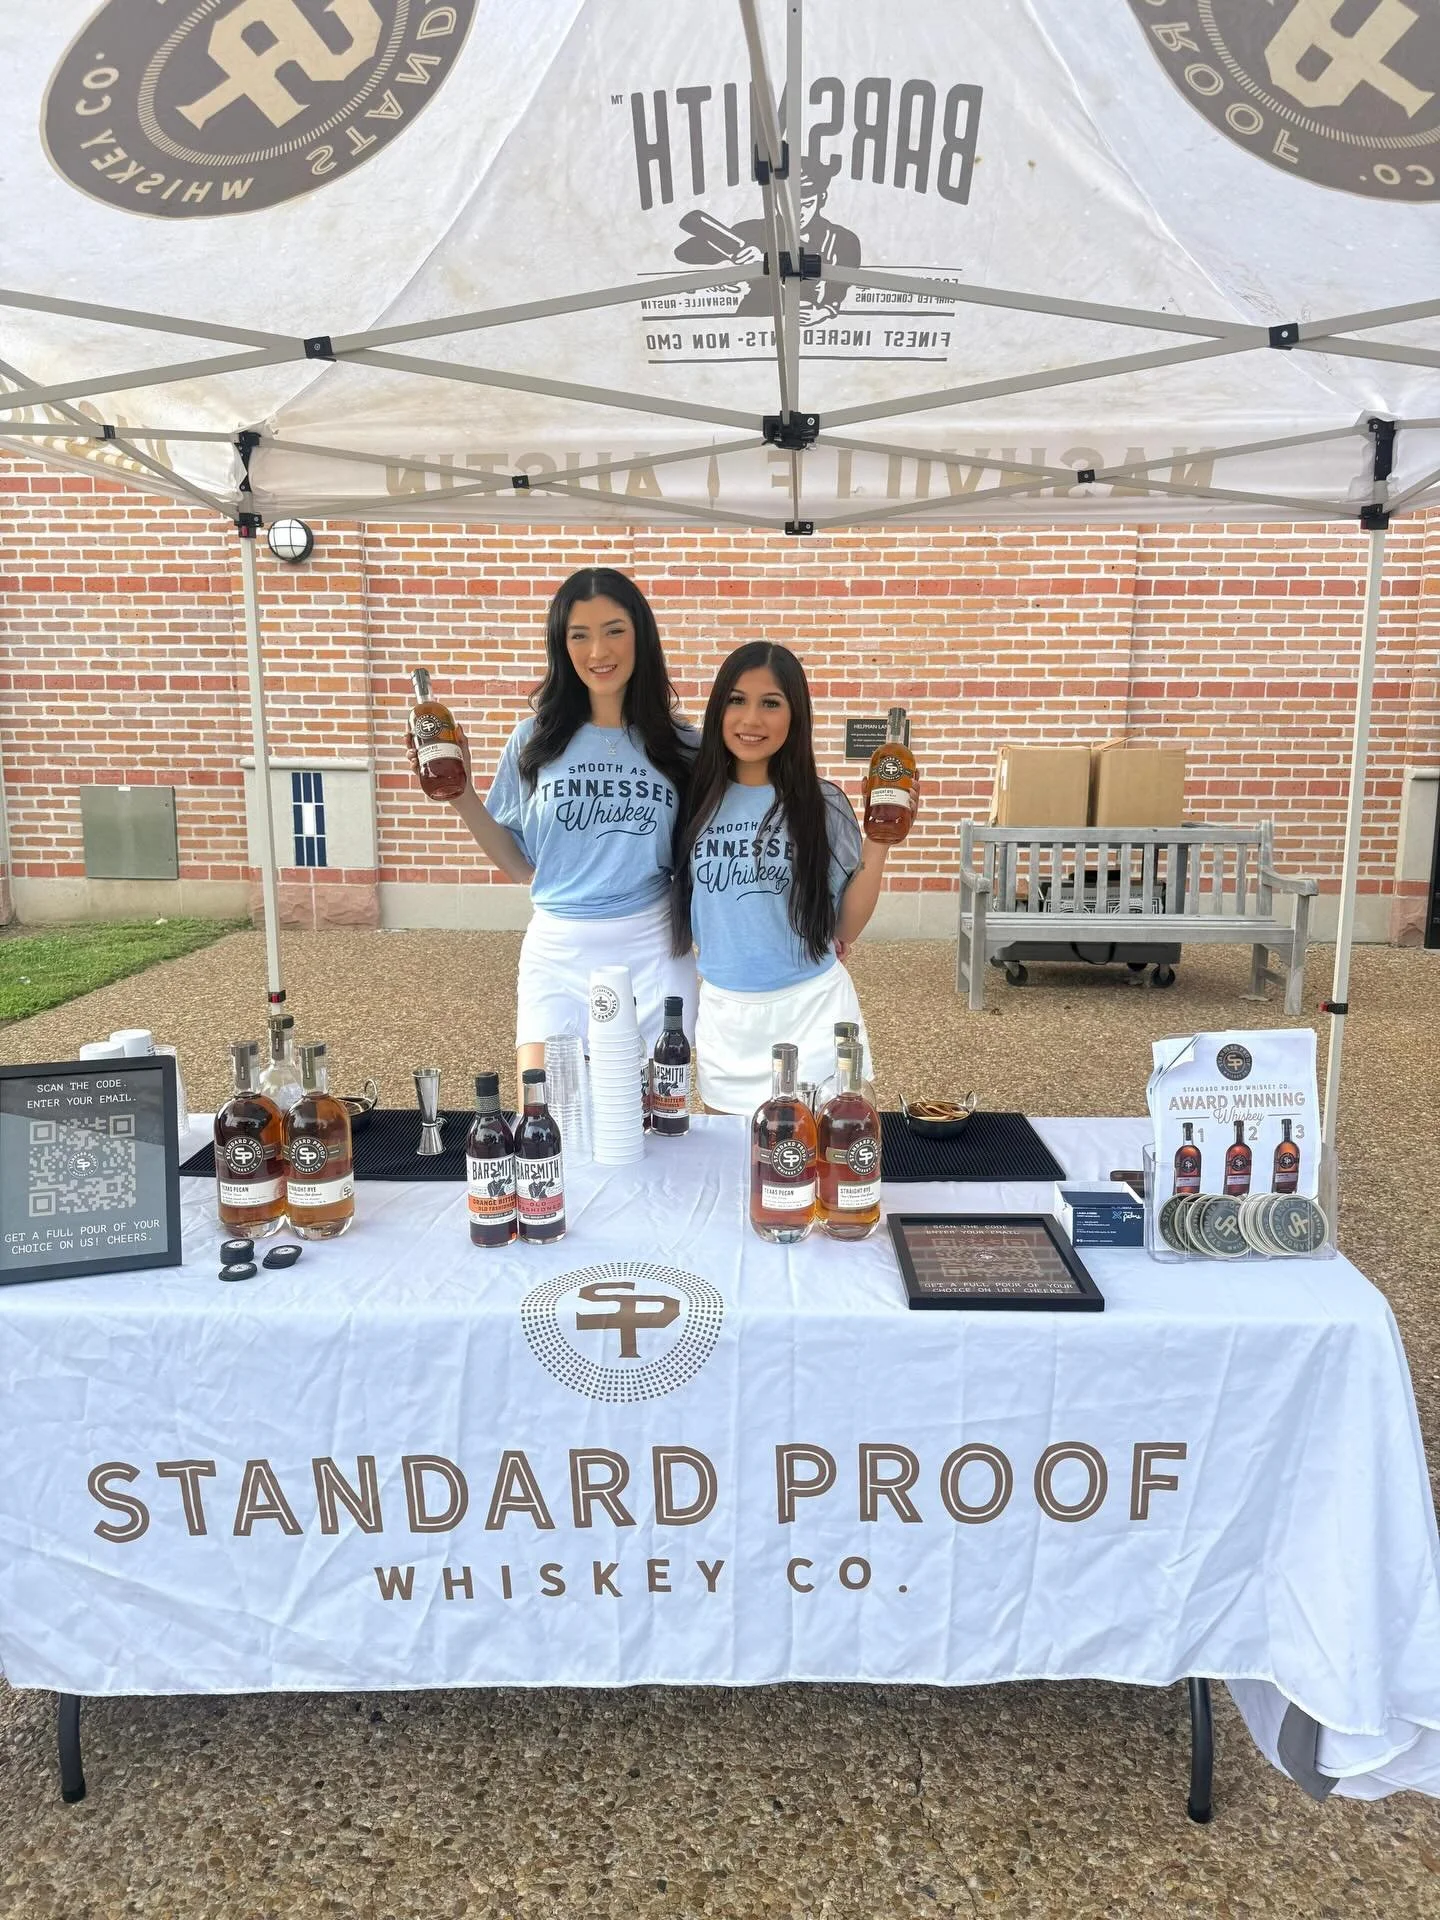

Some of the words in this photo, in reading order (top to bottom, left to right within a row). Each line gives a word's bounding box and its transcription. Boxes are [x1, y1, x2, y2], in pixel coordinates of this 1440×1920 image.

[568, 763, 623, 774] SMOOTH
[630, 767, 648, 777] AS
[541, 779, 674, 809] TENNESSEE
[556, 794, 657, 840] Whiskey
[707, 821, 759, 835] SMOOTH
[765, 824, 783, 834] AS
[696, 855, 790, 901] Whiskey
[36, 1083, 64, 1093] SCAN
[69, 1081, 89, 1091] THE
[95, 1079, 128, 1089] CODE.
[26, 1098, 60, 1109] ENTER
[66, 1096, 93, 1106] YOUR
[99, 1094, 137, 1104] EMAIL.
[1168, 1094, 1228, 1111] AWARD
[1232, 1092, 1306, 1109] WINNING
[1212, 1105, 1265, 1128] Whiskey
[1248, 1126, 1259, 1141] 2
[1295, 1124, 1305, 1140] 3
[234, 1147, 253, 1164] SP
[299, 1147, 317, 1165] SP
[783, 1150, 800, 1167] SP
[858, 1147, 873, 1165] SP
[472, 1198, 497, 1206] ORANGE
[4, 1232, 26, 1243] GET
[32, 1231, 40, 1240] A
[46, 1227, 73, 1239] FULL
[80, 1225, 107, 1235] POUR
[113, 1222, 127, 1232] OF
[133, 1219, 160, 1230] YOUR
[11, 1242, 53, 1255] CHOICE
[59, 1240, 74, 1250] ON
[79, 1237, 99, 1248] US!
[106, 1232, 153, 1245] CHEERS.
[576, 1281, 681, 1358] SP
[87, 1445, 719, 1544] STANDARD
[775, 1440, 1188, 1525] PROOF
[373, 1558, 726, 1601] WHISKEY
[786, 1555, 909, 1594] CO.
